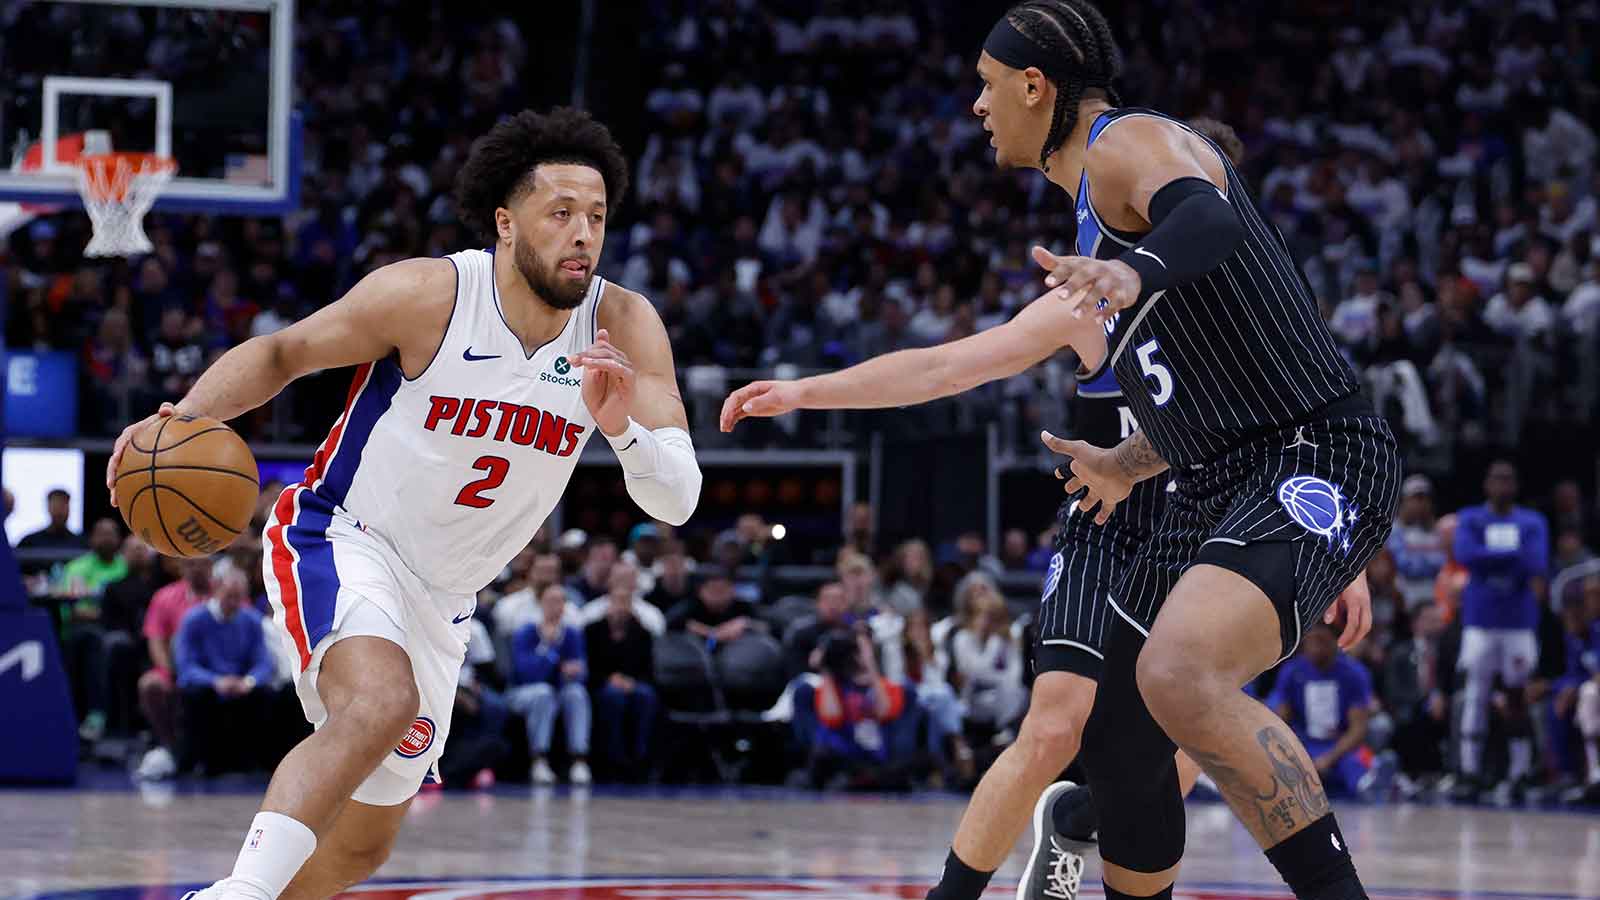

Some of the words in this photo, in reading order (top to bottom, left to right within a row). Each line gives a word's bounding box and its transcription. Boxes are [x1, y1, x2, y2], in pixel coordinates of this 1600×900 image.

[540, 371, 581, 387] StockX
[1135, 337, 1174, 407] 5
[424, 395, 585, 457] PISTONS
[453, 455, 511, 509] 2
